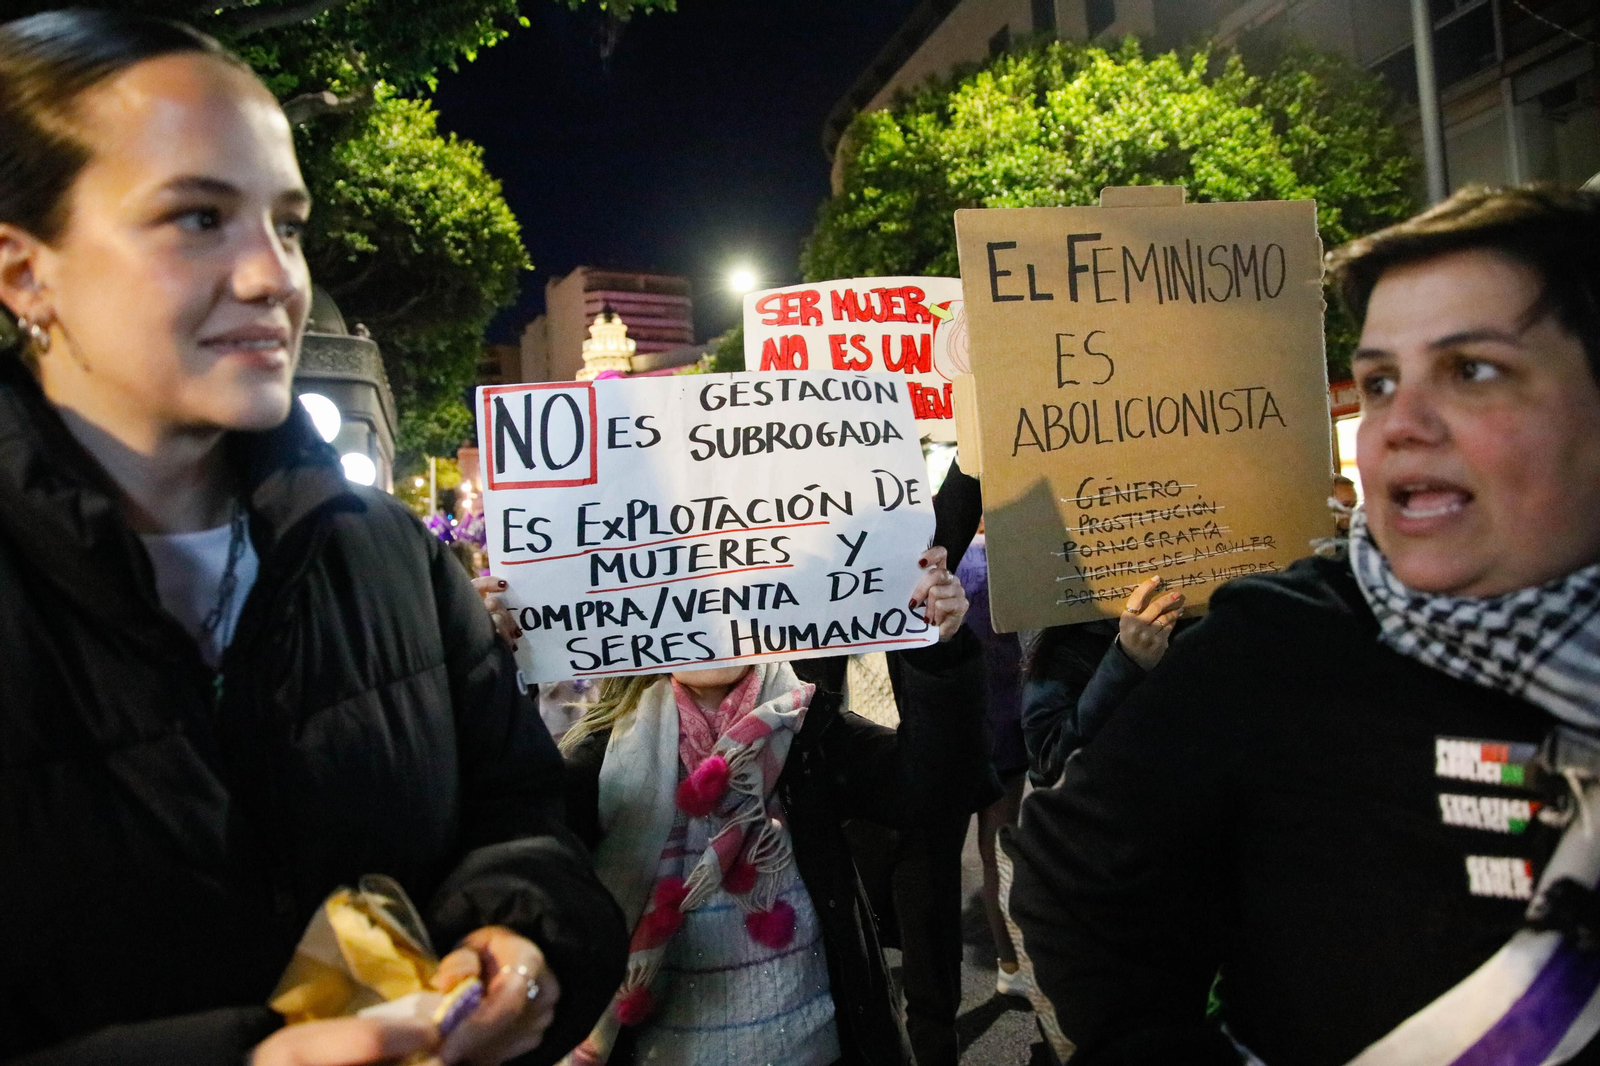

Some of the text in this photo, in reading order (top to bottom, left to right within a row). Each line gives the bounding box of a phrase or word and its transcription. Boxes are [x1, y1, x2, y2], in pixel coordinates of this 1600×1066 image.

[987, 233, 1286, 305] EL FEMINISMO
[755, 286, 934, 327] SER MUJER
[759, 333, 932, 374] NO ES UN
[1055, 330, 1114, 389] ES
[699, 375, 899, 412] GESTACIÓN
[1012, 386, 1287, 457] ABOLICIONISTA
[494, 393, 661, 474] NO ES
[688, 419, 903, 461] SUBROGADA
[502, 508, 553, 553] ES
[872, 469, 922, 512] DE
[1076, 476, 1182, 510] GÉNERO
[590, 530, 868, 587] MUJERES Y
[1074, 557, 1159, 582] VIENTRES
[1163, 551, 1186, 568] DE
[507, 567, 883, 632] OMPRA/VENTA DE
[1064, 585, 1140, 607] BORRAD
[566, 605, 929, 671] SERES HUMANOS
